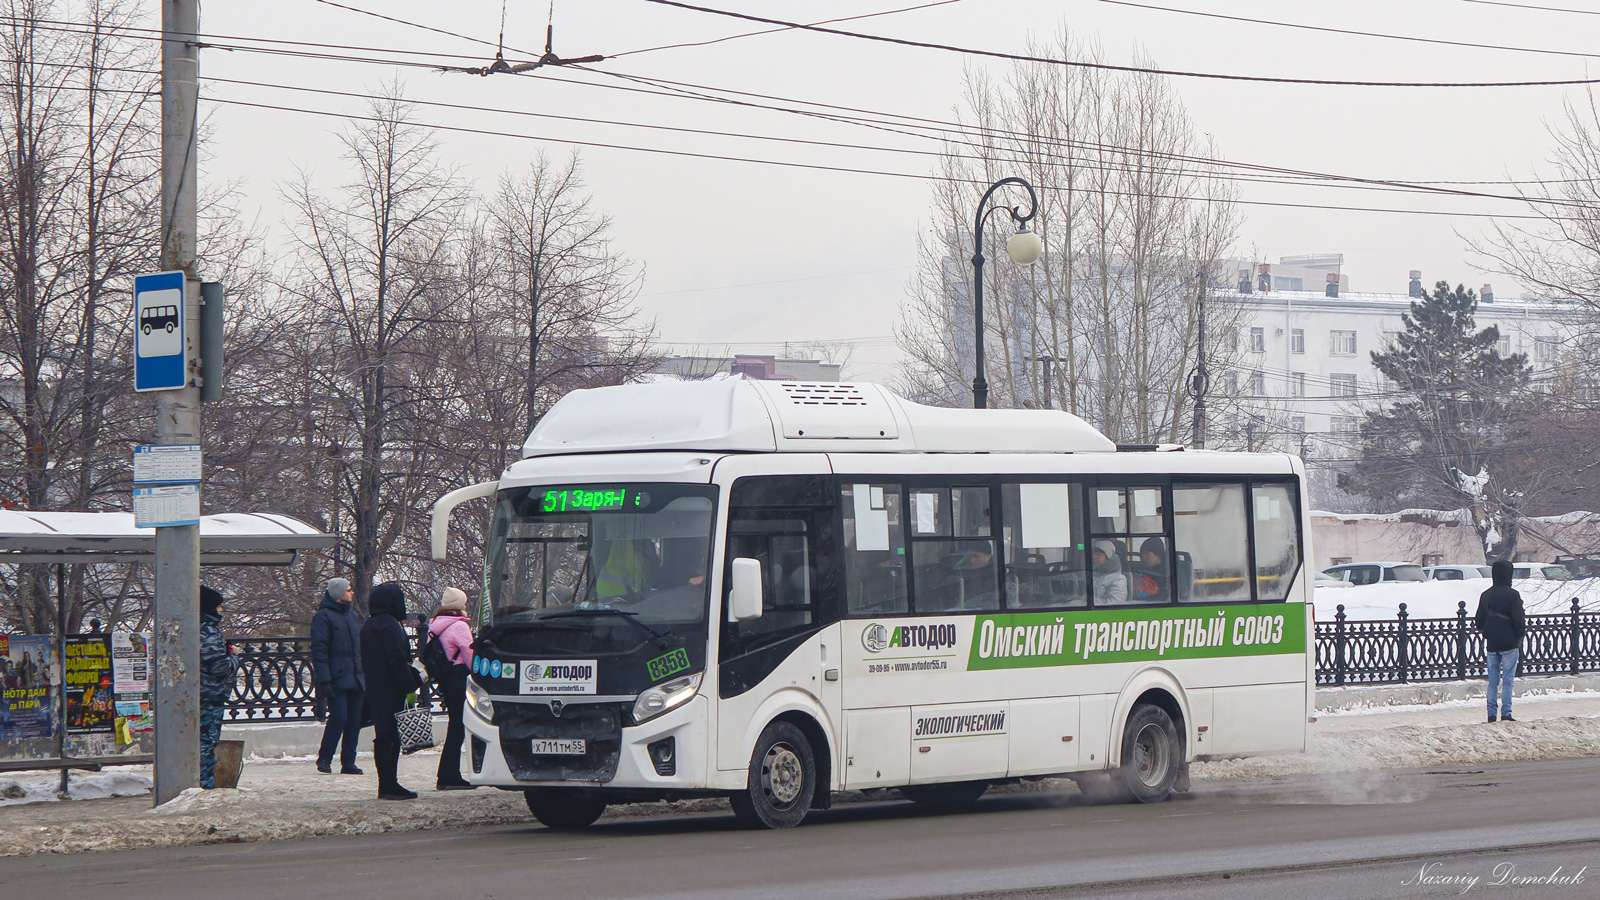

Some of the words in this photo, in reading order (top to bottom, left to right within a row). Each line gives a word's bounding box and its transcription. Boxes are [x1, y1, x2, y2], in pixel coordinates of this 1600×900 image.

[543, 490, 568, 512] 51
[978, 616, 1066, 660] Омский
[1073, 610, 1227, 660] транспортный
[1232, 614, 1286, 647] союз
[649, 650, 688, 679] 8358
[894, 659, 948, 673] www.avtodor55.ru
[2, 689, 26, 699] НОТР
[28, 688, 46, 699] ДАМ
[915, 710, 1005, 736] ЭКОЛОГИЧЕСКИЙ
[572, 740, 582, 750] 55
